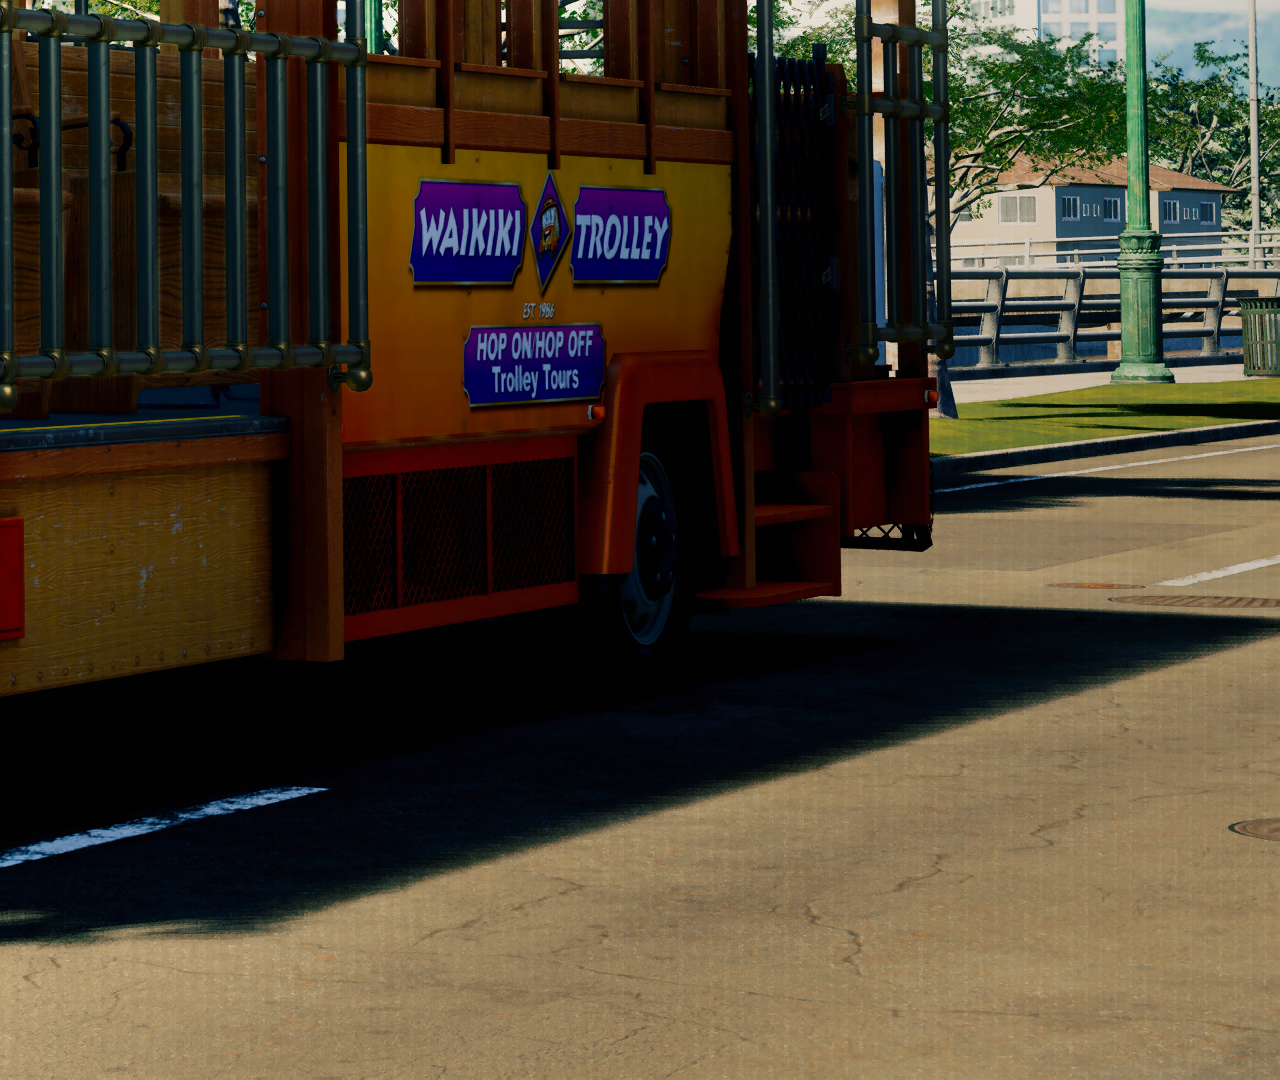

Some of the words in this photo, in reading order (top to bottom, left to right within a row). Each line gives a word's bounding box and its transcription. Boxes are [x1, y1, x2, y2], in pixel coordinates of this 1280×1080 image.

[420, 206, 521, 258] WAIKIKI
[576, 214, 668, 260] TROLLEY
[522, 302, 537, 319] EST.
[538, 302, 555, 319] 1986
[476, 332, 507, 361] HOP
[567, 330, 593, 357] OFF
[491, 365, 539, 399] Trolley
[542, 363, 579, 390] Tours
